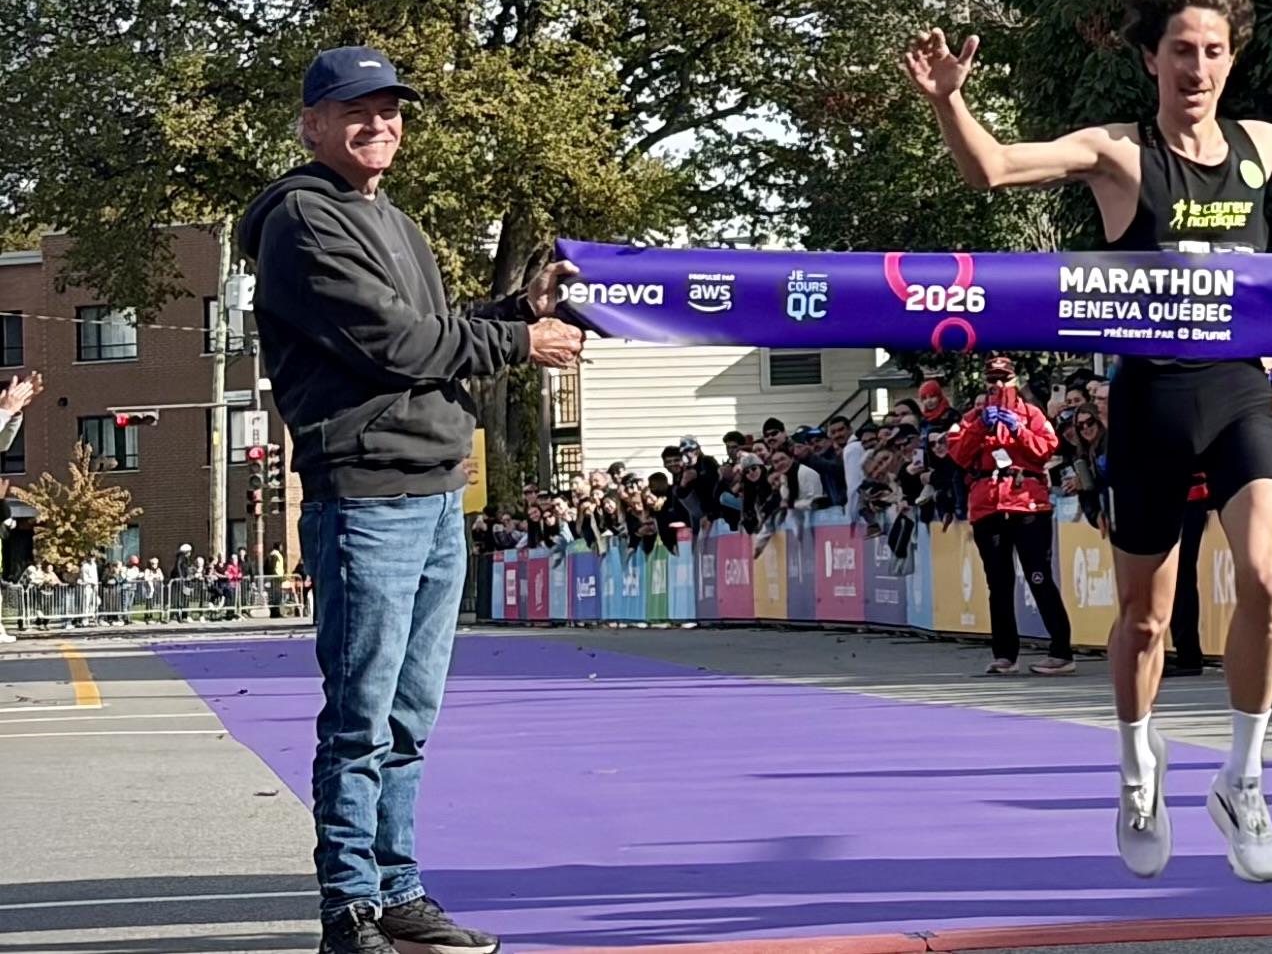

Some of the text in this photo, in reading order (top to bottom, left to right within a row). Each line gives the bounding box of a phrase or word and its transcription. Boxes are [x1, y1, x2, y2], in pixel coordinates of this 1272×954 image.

[788, 270, 803, 281] JE
[1059, 266, 1235, 297] MARATHON
[689, 283, 731, 301] aws
[787, 281, 828, 293] COURS
[786, 293, 828, 321] QC
[906, 285, 986, 313] 2026
[1058, 298, 1233, 323] BENEVA QUÉBEC
[1154, 329, 1175, 340] PAR
[1191, 328, 1232, 342] Brunet
